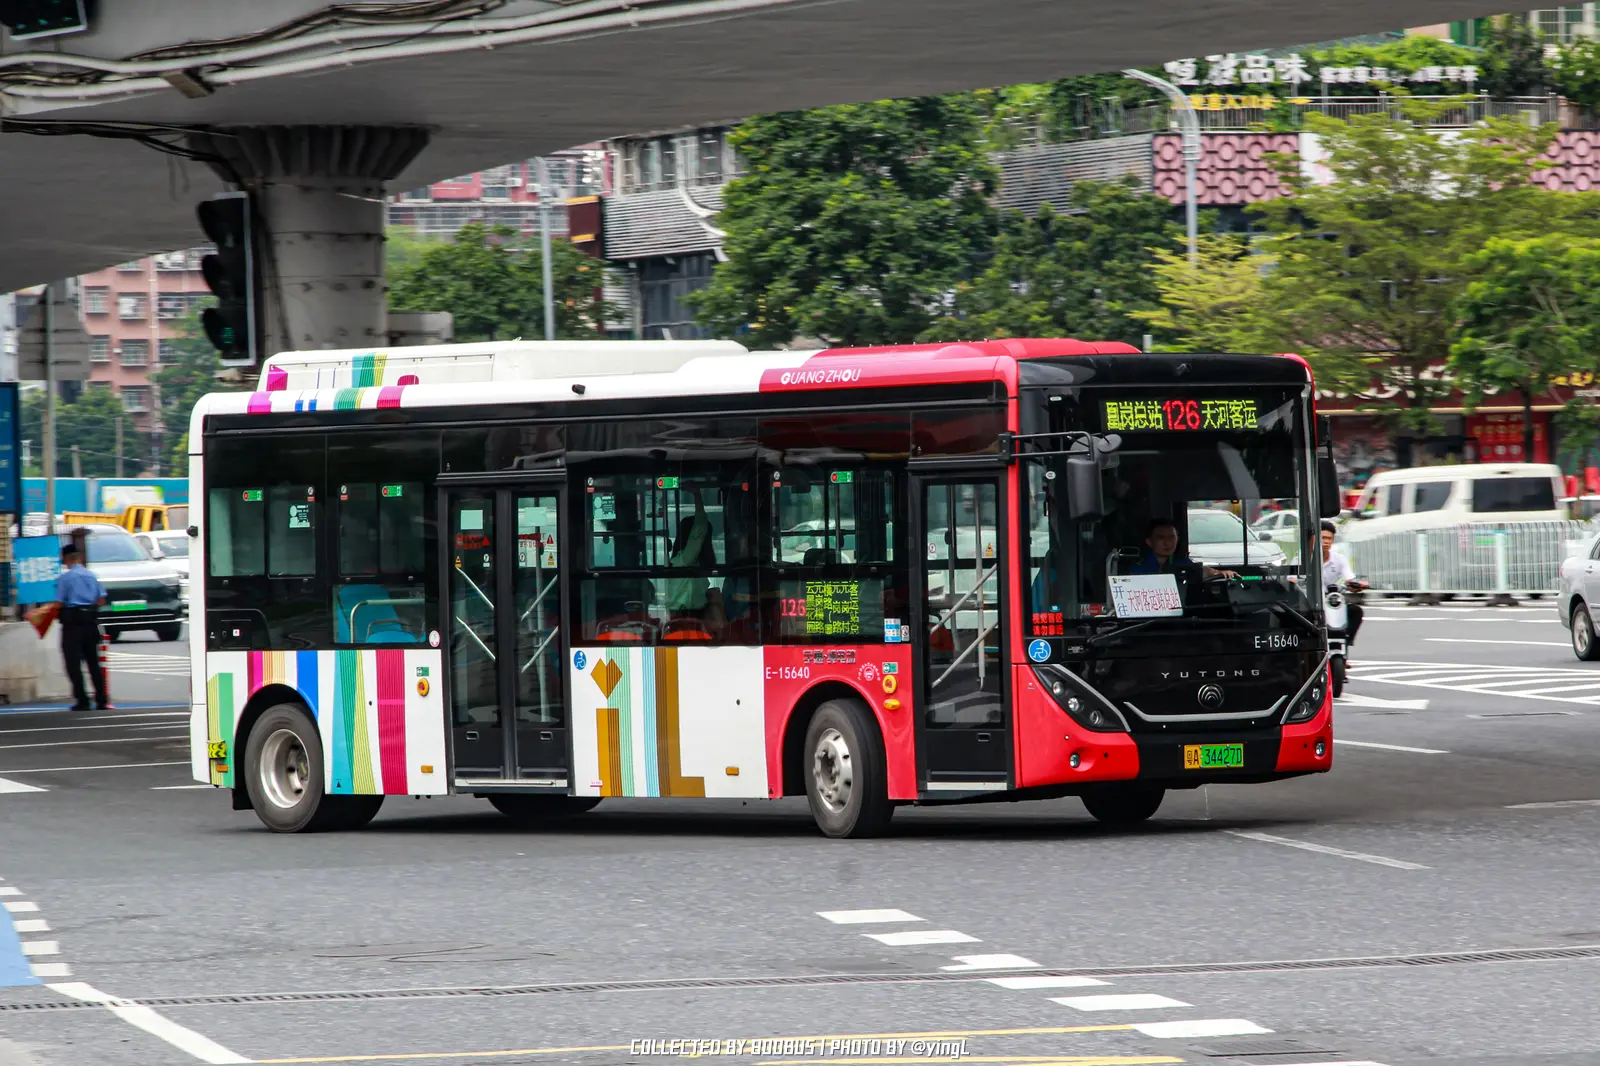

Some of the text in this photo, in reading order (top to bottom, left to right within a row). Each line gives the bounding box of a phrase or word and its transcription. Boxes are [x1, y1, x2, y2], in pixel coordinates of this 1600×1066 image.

[781, 368, 862, 385] GUANGZHOU
[1162, 400, 1200, 430] 126
[1201, 400, 1258, 429] 天河客运
[781, 599, 806, 616] 126
[1254, 635, 1299, 649] E-15640
[765, 666, 810, 680] E-15640
[1161, 669, 1260, 679] YUTONG
